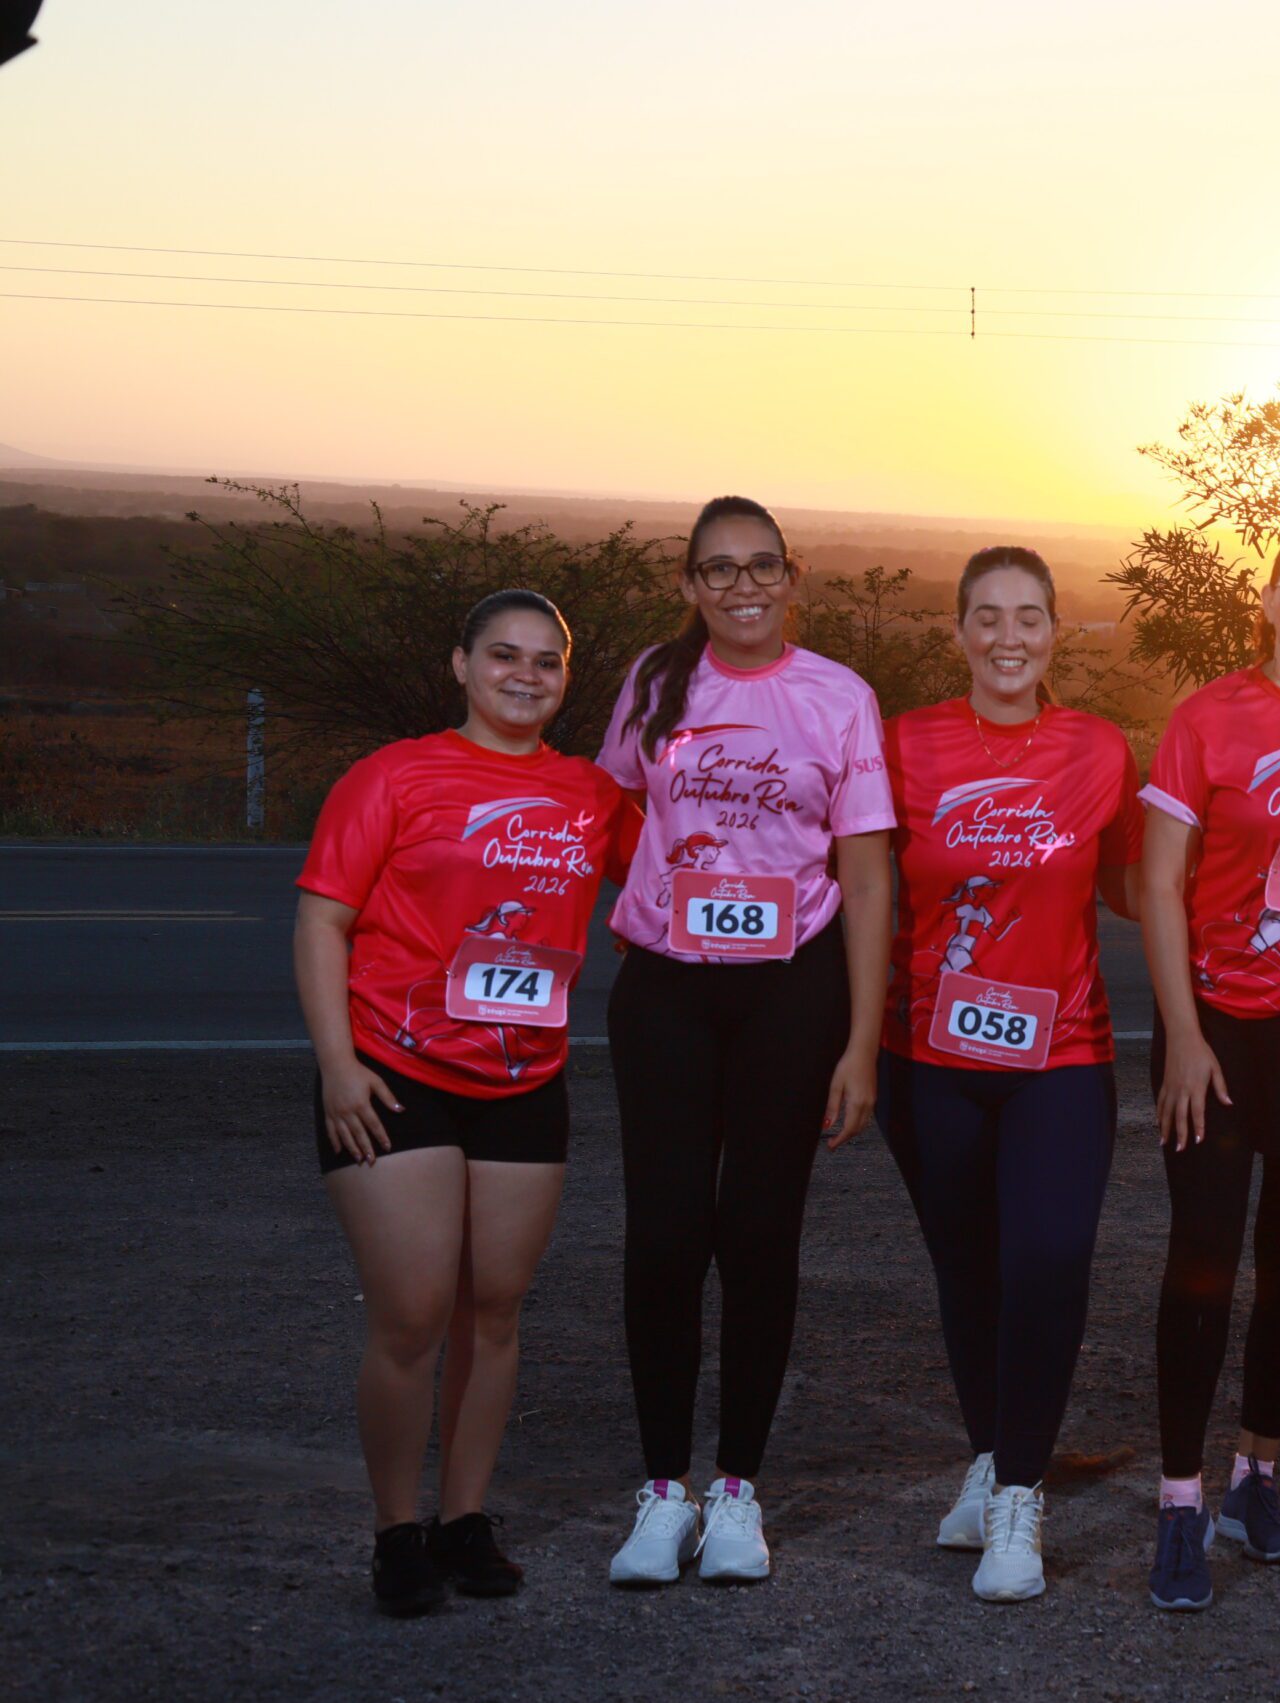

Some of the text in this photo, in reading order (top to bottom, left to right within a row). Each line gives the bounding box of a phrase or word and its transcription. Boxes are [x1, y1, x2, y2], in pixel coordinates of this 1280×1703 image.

[697, 744, 789, 776] Corrida
[853, 755, 884, 775] SUS
[669, 772, 750, 808] Outubro
[716, 811, 758, 830] 2026
[973, 796, 1055, 822] Corrida
[507, 814, 583, 843] Corrida
[946, 820, 1022, 849] Outubro
[483, 838, 560, 872] Outubro
[988, 851, 1034, 868] 2026
[523, 876, 570, 896] 2026
[702, 903, 764, 935] 168
[482, 967, 540, 1002] 174
[958, 1006, 1027, 1045] 058
